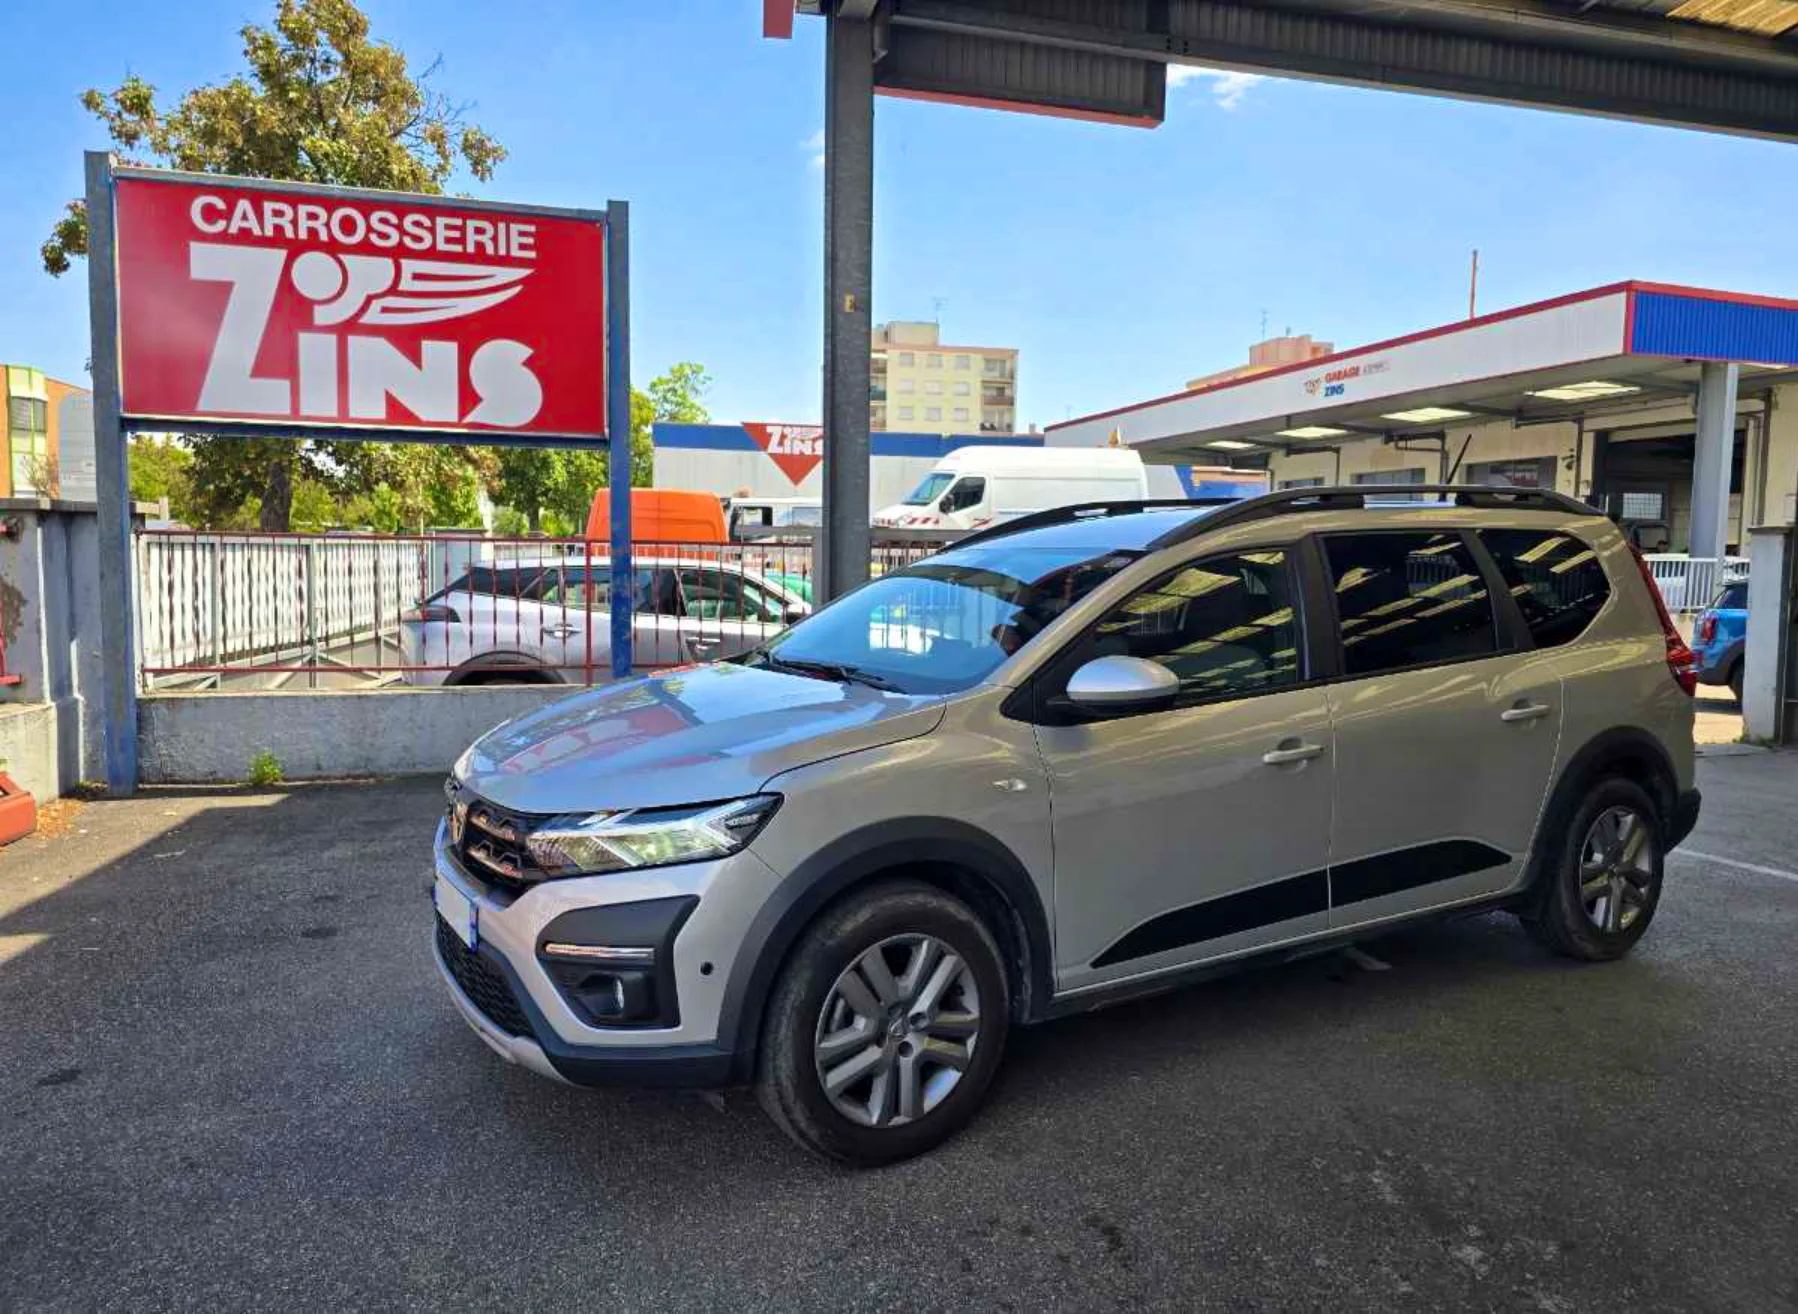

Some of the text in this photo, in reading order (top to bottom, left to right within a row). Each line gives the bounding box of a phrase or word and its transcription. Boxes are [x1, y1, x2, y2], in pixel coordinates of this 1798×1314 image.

[190, 194, 537, 259] CARROSSERIE
[189, 241, 544, 427] ZINS
[1324, 383, 1344, 397] ZINS
